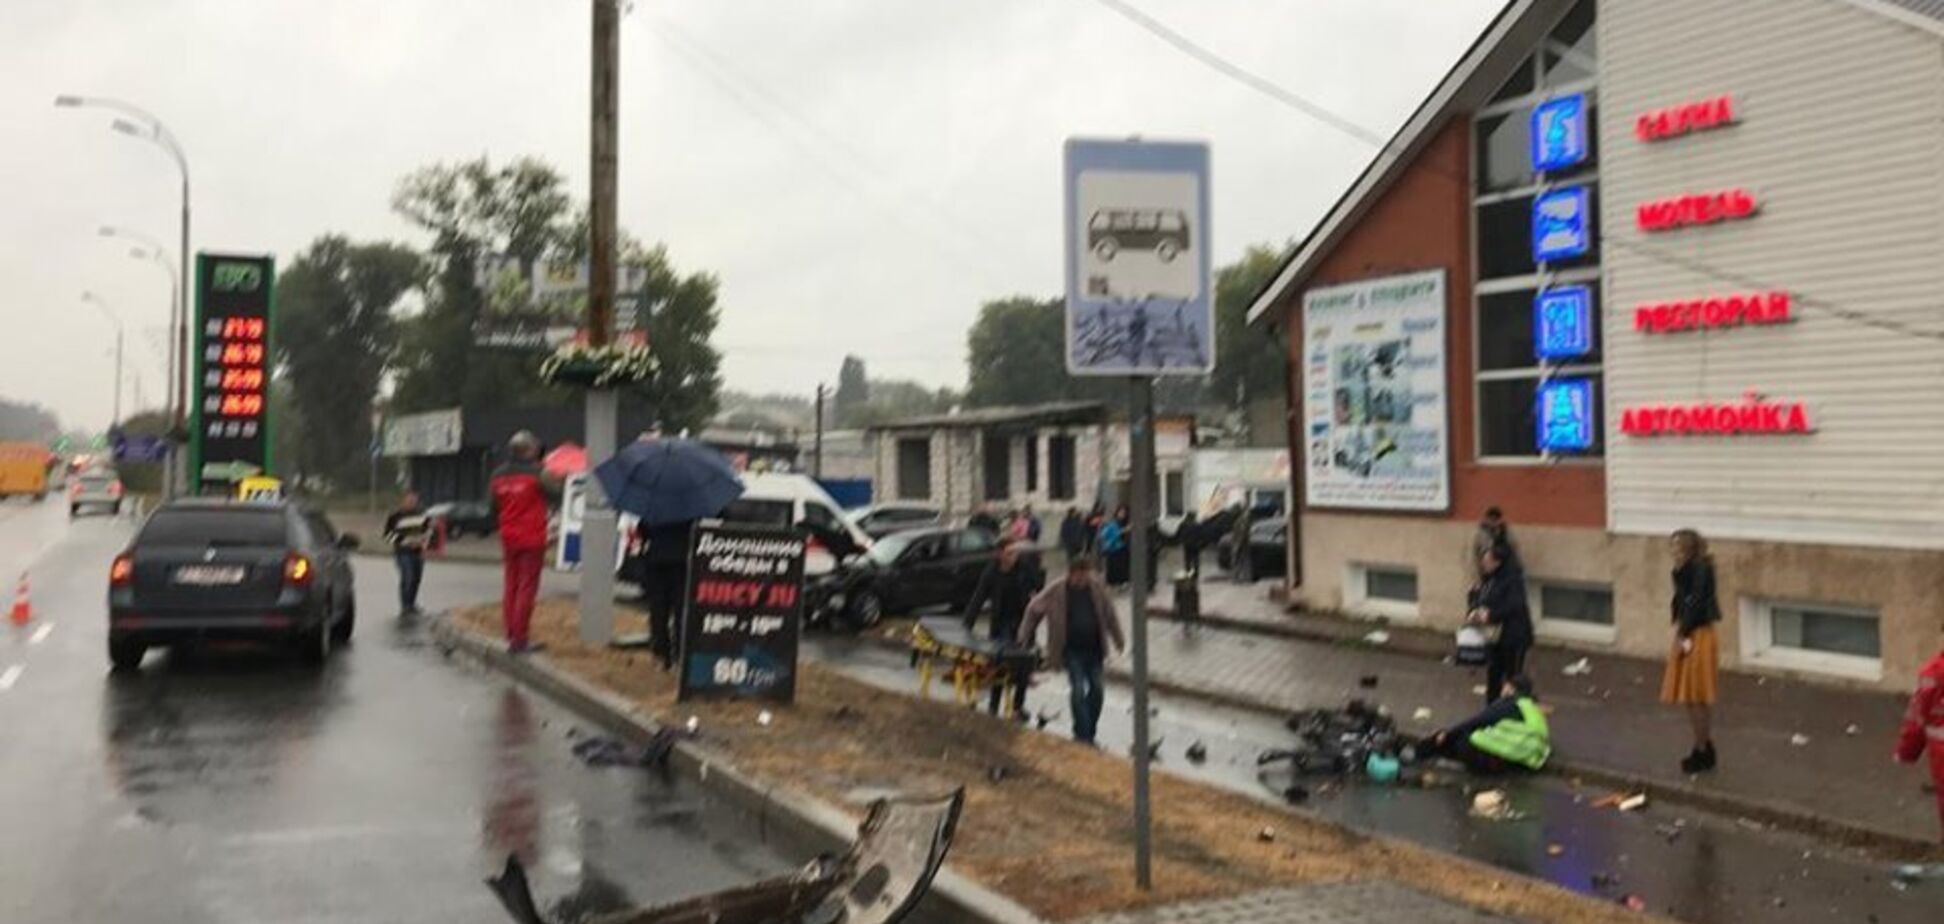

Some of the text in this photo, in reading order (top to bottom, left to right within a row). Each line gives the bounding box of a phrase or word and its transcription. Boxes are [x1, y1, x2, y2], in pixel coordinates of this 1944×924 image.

[1635, 96, 1734, 142] САУНА
[1637, 189, 1756, 232] МОТЕЛЬ
[1635, 293, 1791, 333] РЕСТОРАН
[1621, 388, 1809, 436] АВТОМОЙКА
